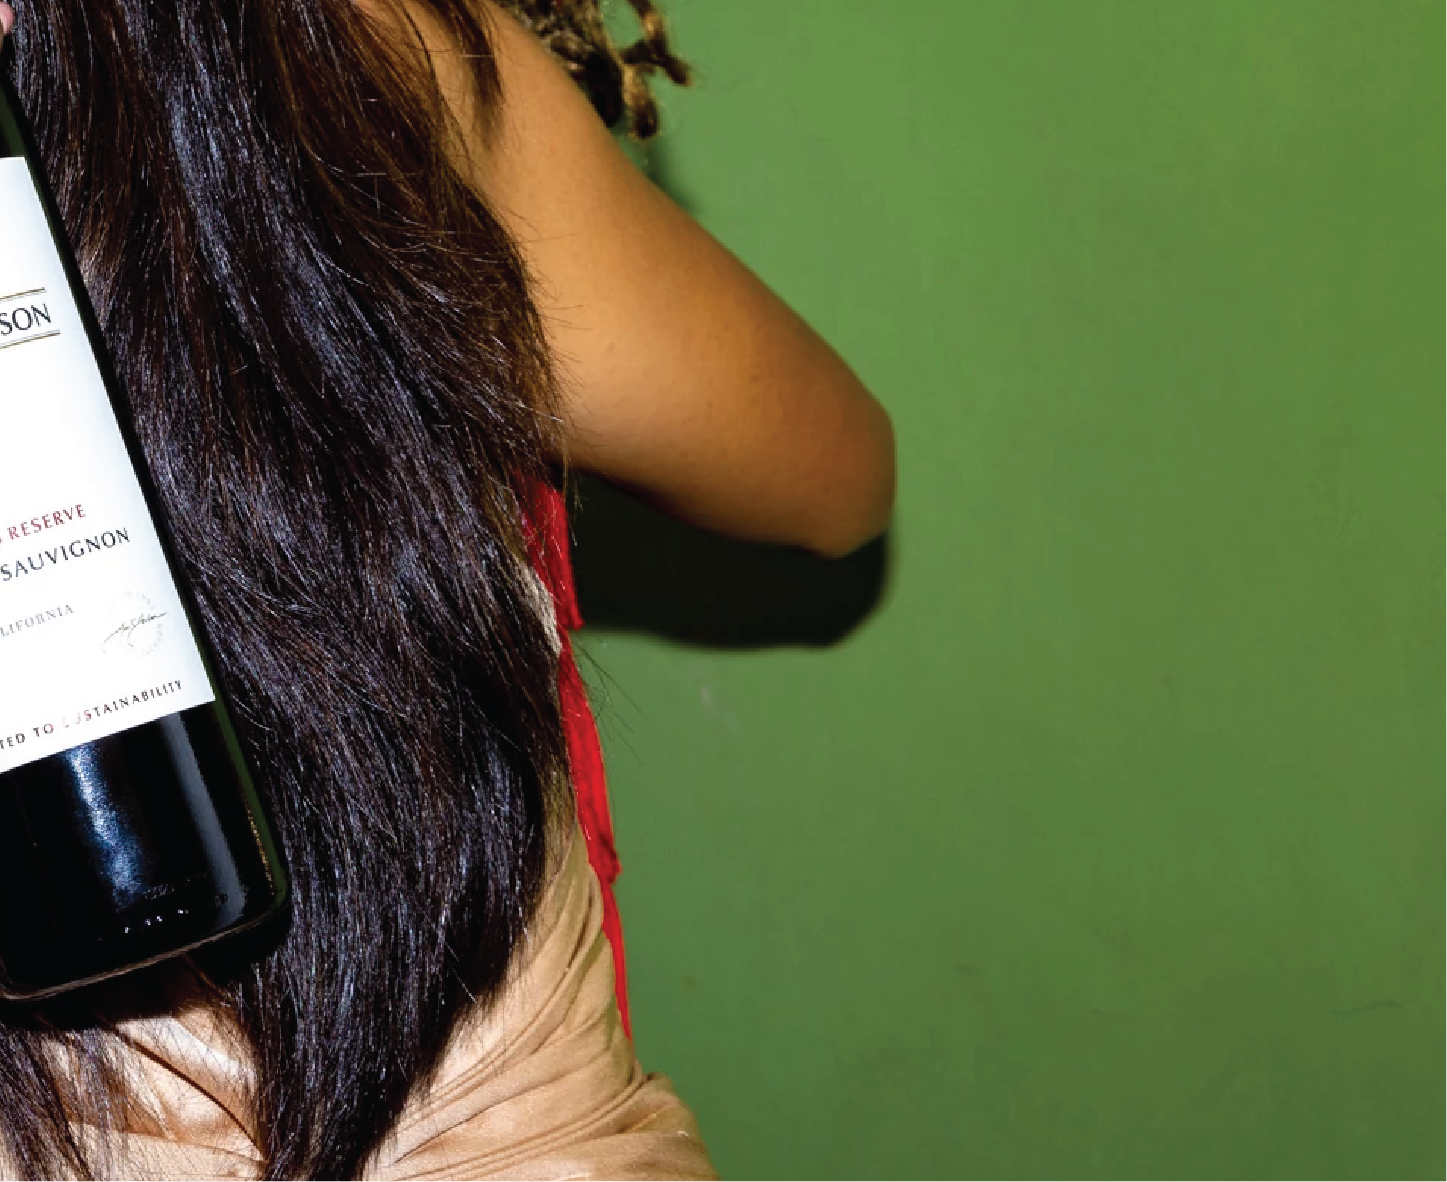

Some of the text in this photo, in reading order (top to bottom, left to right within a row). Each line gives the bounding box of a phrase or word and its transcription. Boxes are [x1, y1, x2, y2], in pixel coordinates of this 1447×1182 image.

[7, 504, 86, 540] RESERVE
[0, 527, 131, 582] SAUVIGNON
[33, 723, 55, 738] TO
